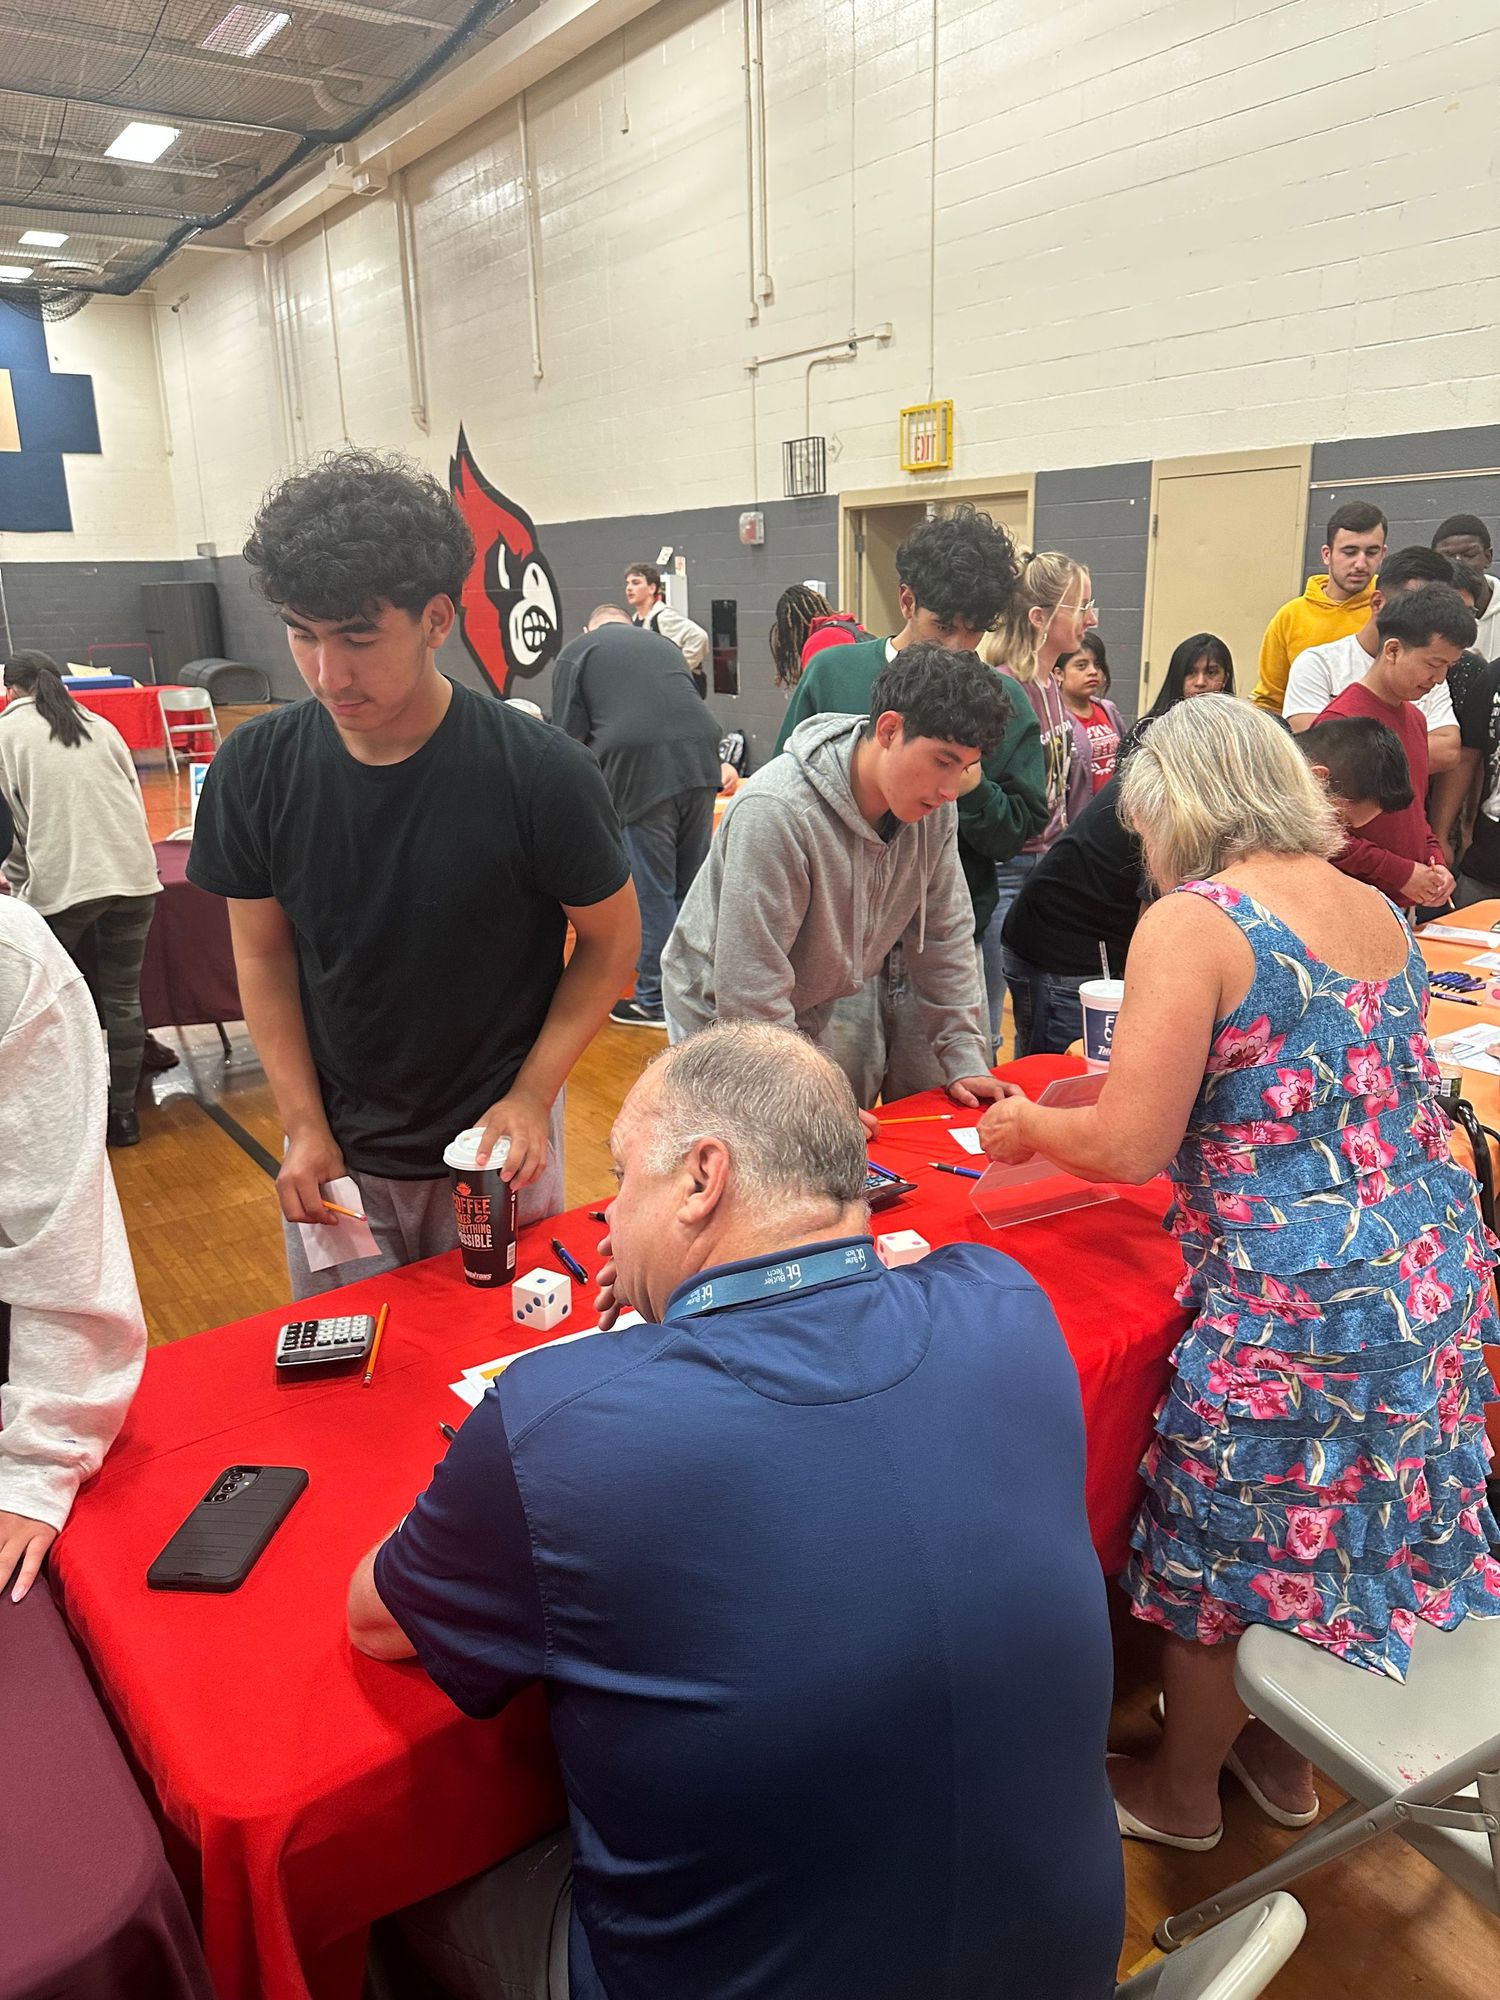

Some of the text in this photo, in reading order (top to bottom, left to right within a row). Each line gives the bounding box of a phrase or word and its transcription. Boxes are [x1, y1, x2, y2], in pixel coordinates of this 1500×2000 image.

[914, 433, 936, 461] EXIT
[766, 1267, 784, 1277] Tech
[763, 1274, 786, 1285] Butler
